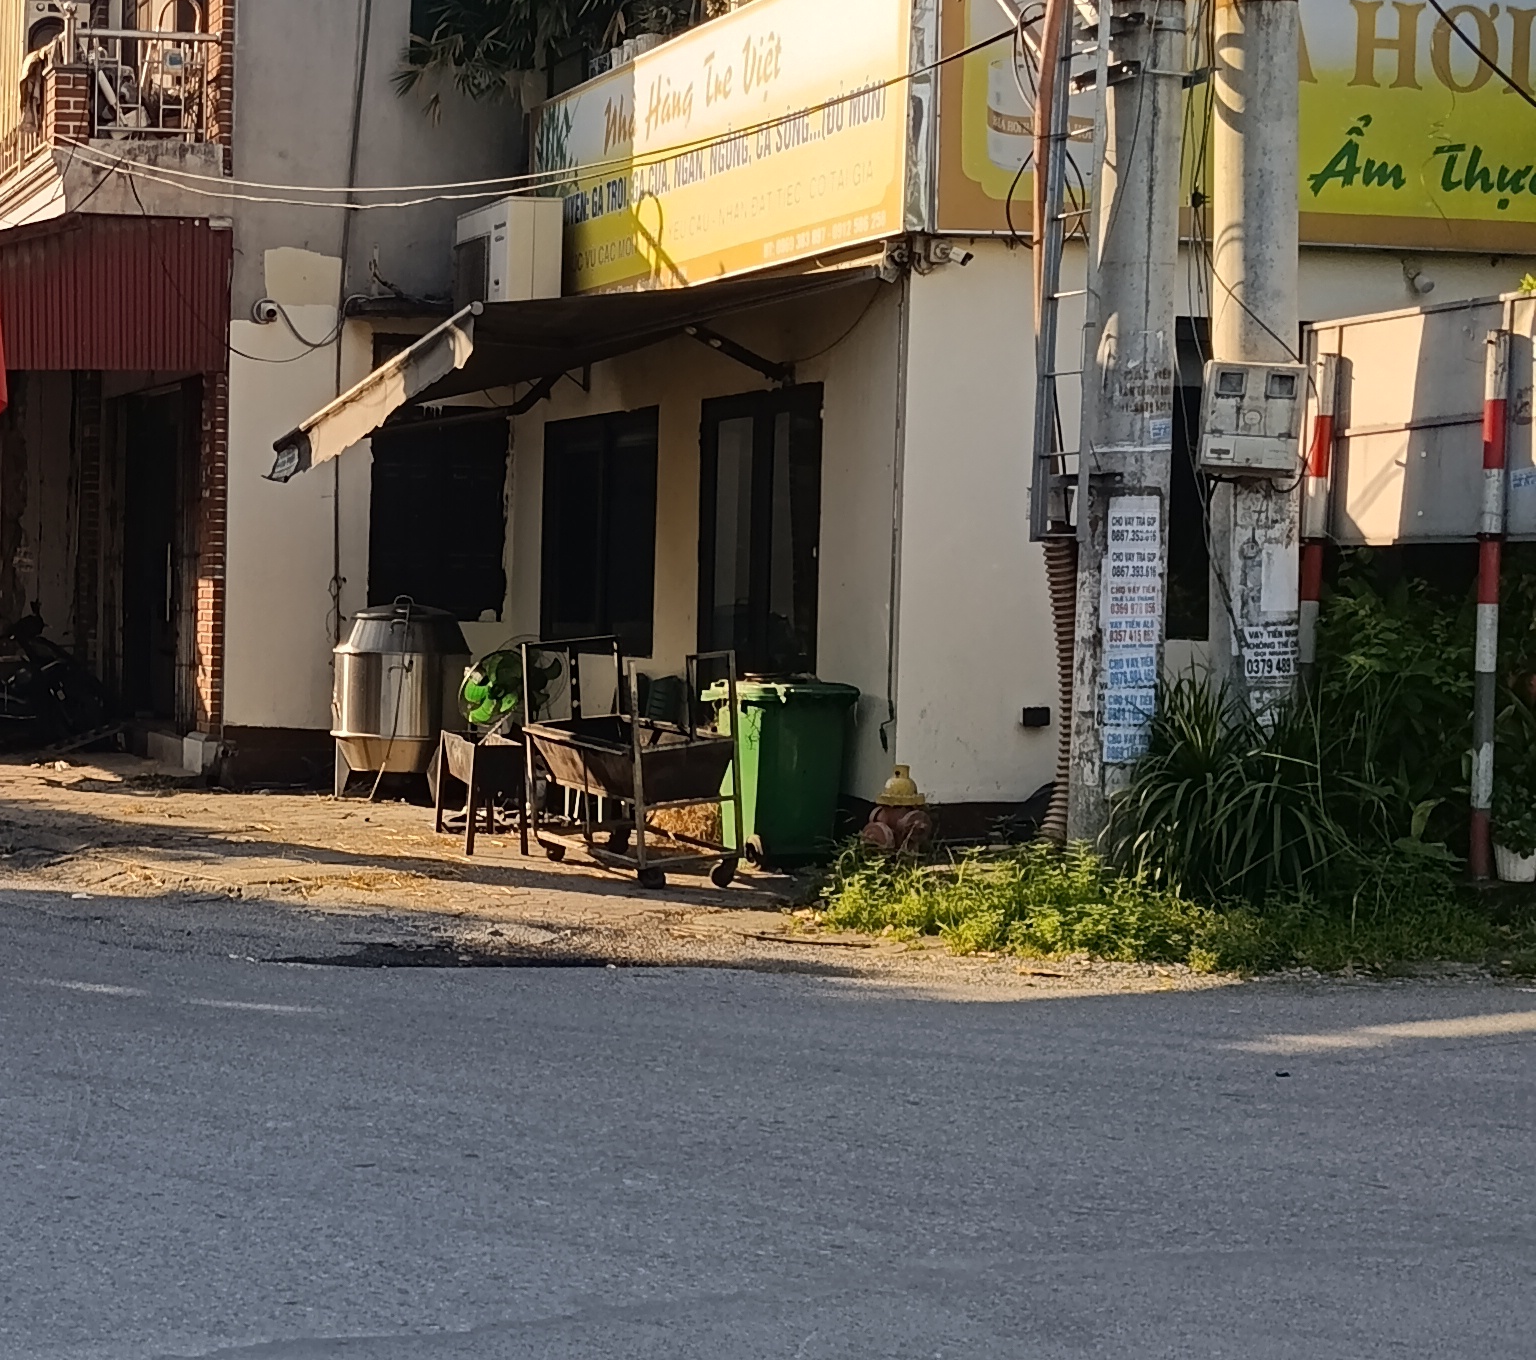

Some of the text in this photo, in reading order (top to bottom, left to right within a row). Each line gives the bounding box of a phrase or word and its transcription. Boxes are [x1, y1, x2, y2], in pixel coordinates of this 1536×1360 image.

[645, 74, 693, 142] Hàng
[703, 51, 733, 107] Tre
[742, 31, 782, 103] Việt
[674, 150, 706, 189] NGAN,
[1307, 114, 1406, 197] Ẩm
[1246, 659, 1273, 674] 0379
